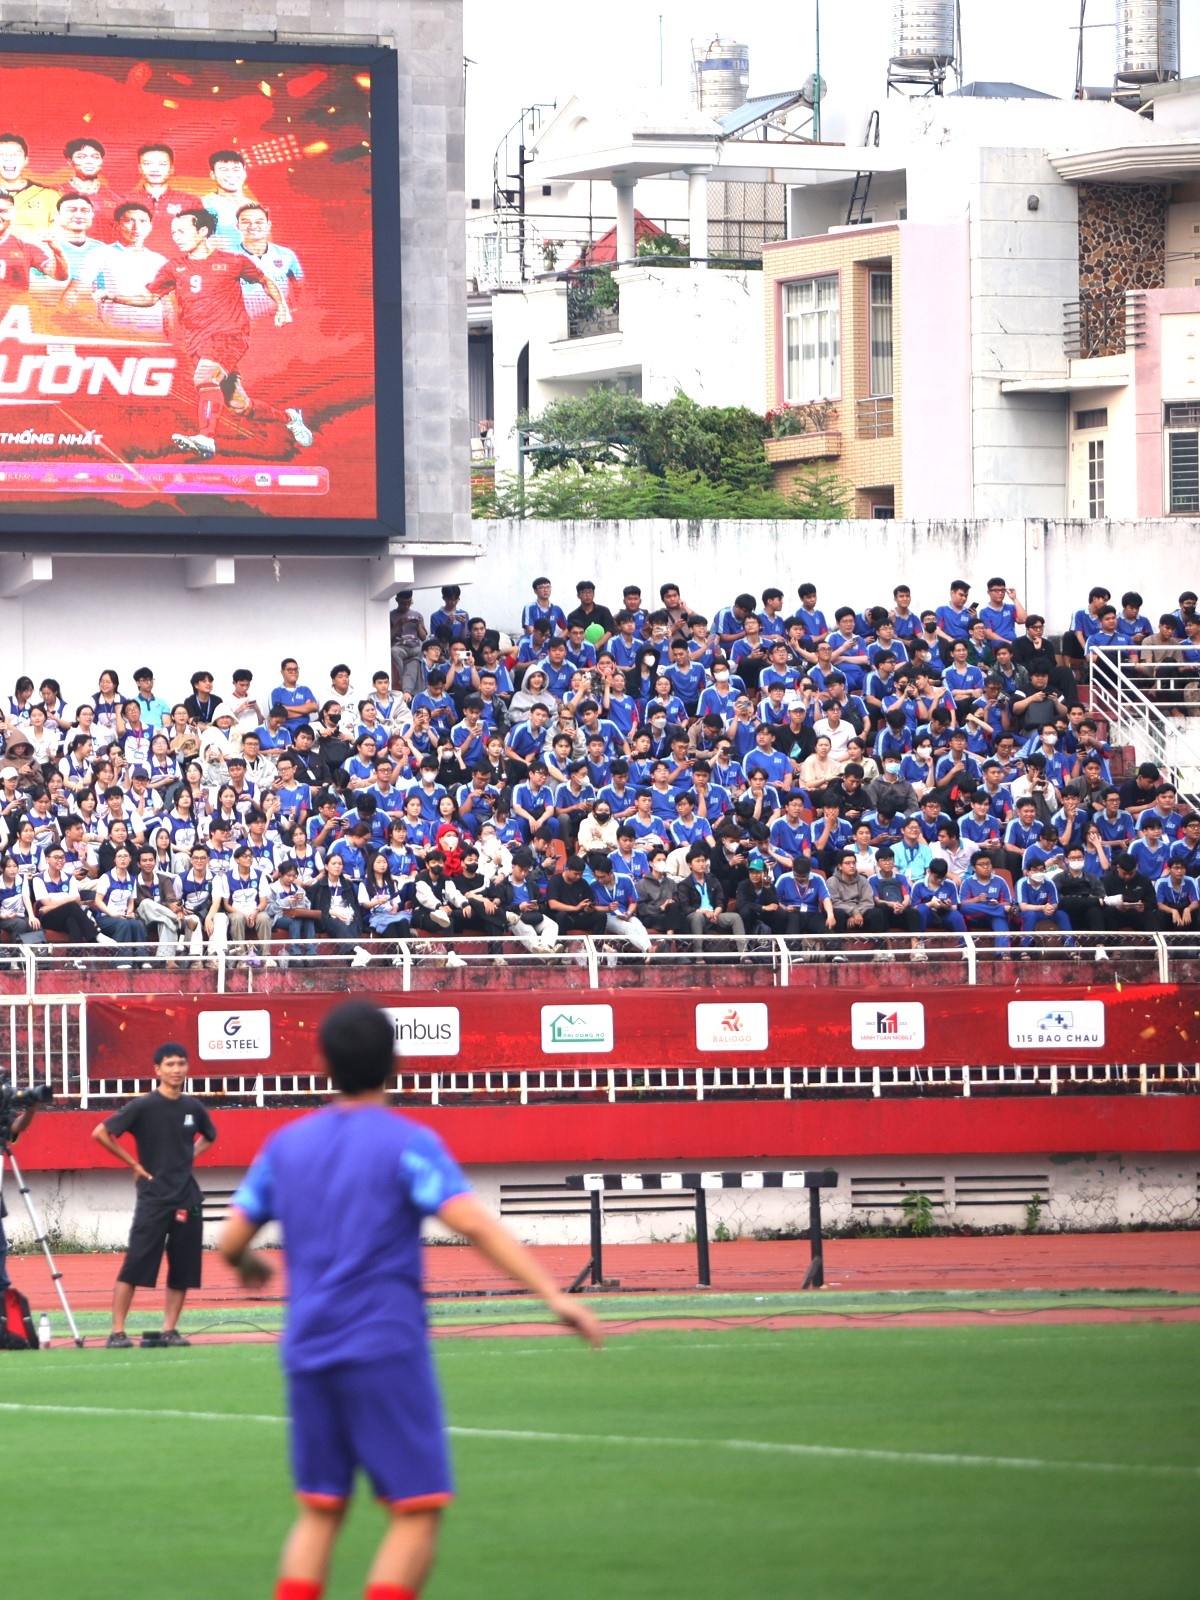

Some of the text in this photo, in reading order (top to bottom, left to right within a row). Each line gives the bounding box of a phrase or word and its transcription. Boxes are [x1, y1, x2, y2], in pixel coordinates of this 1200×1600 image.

[189, 274, 202, 294] 9
[0, 428, 54, 445] THỐNG
[58, 429, 103, 446] NHẤT
[395, 1018, 452, 1040] inbus
[208, 1039, 259, 1050] GB STEEL
[1016, 1034, 1098, 1043] 115 BAO CHAU
